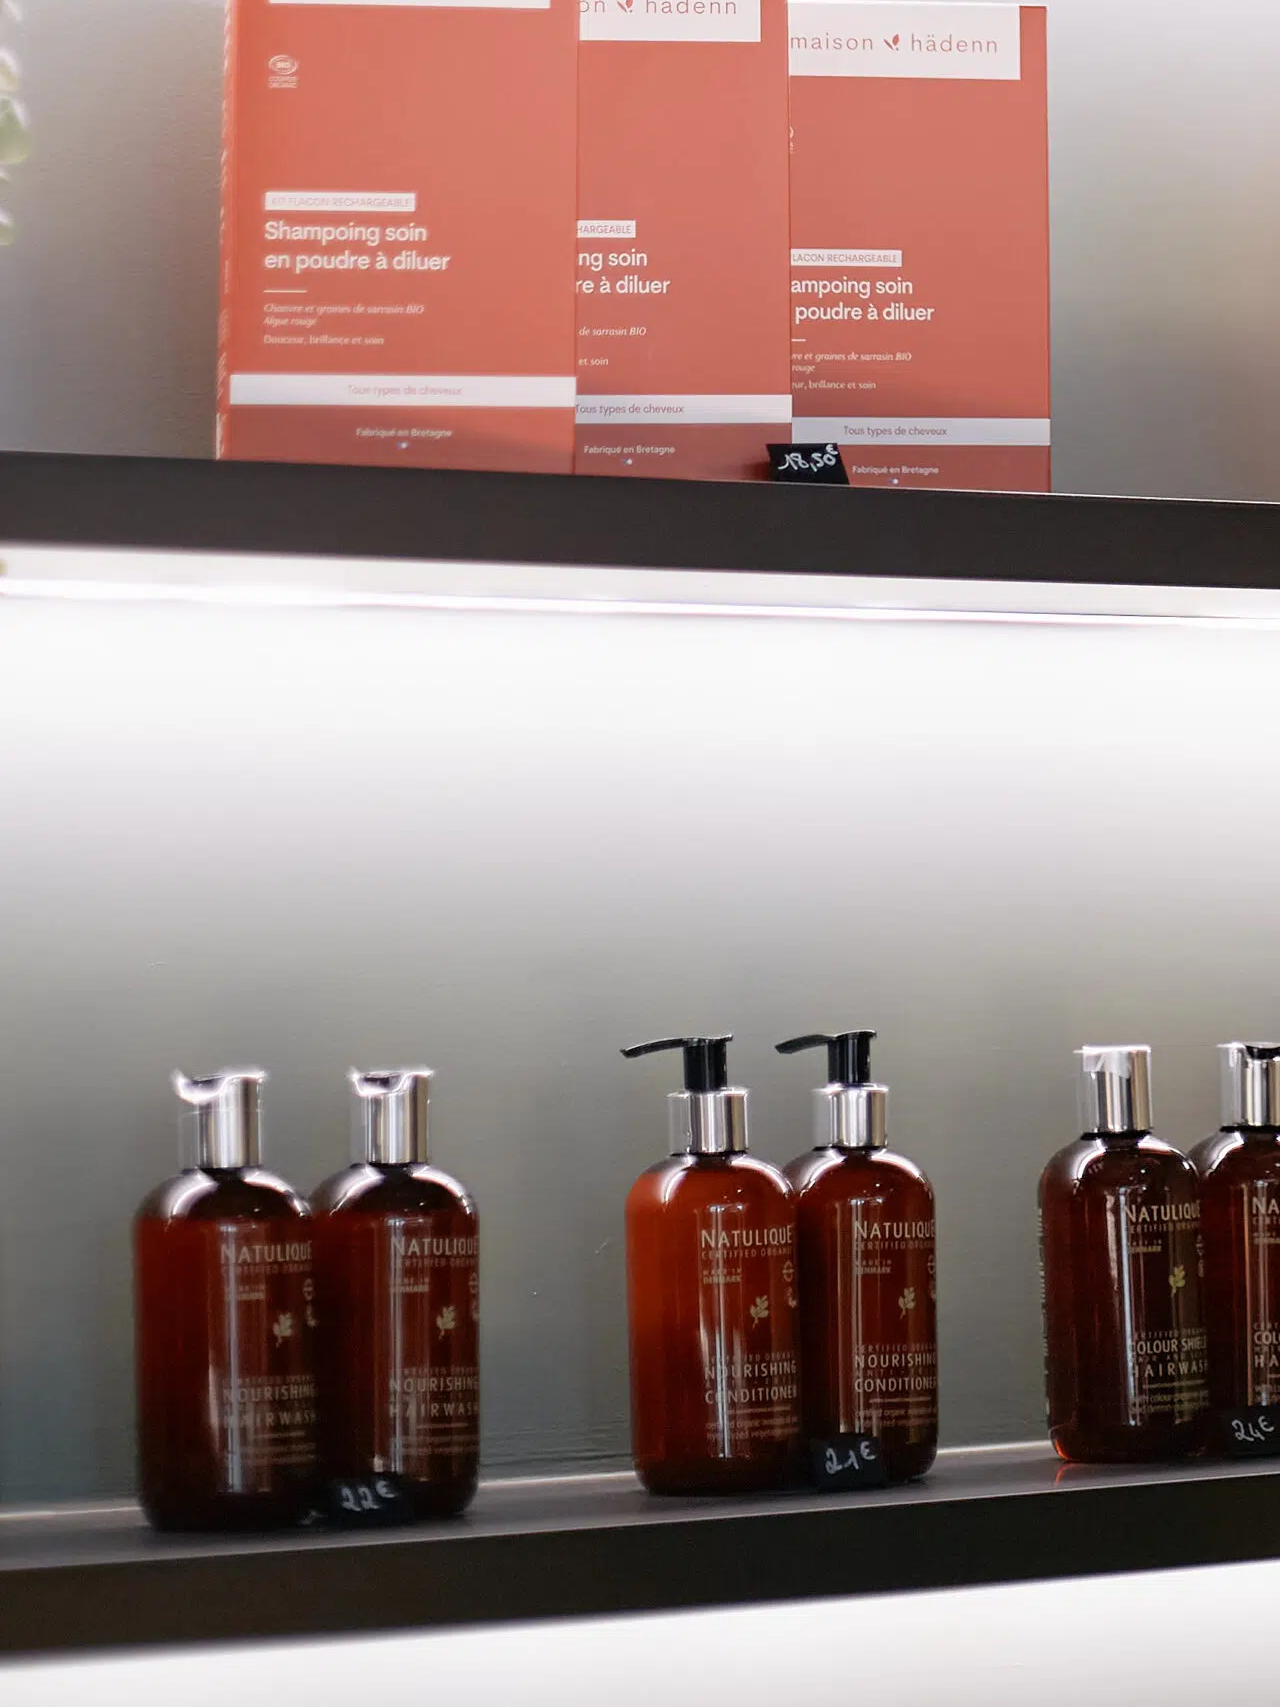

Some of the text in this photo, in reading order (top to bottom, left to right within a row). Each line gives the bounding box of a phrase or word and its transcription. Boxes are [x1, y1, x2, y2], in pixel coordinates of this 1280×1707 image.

[790, 32, 998, 54] maison hädenn
[264, 220, 427, 246] Shampoing soin
[264, 250, 451, 274] en poudre à diluer
[608, 248, 648, 266] soin
[827, 253, 898, 263] RECHARGEABLE
[599, 275, 611, 293] à
[615, 275, 671, 293] diluer
[875, 276, 913, 294] soin
[352, 303, 364, 313] de
[406, 304, 425, 314] BIO
[795, 301, 935, 325] poudre à diluer
[578, 326, 647, 336] de sarrasin BIO
[351, 335, 363, 344] et
[364, 335, 385, 344] soin
[578, 357, 609, 366] et soin
[847, 351, 859, 361] de
[895, 351, 912, 361] BIO
[847, 381, 856, 389] et
[858, 380, 877, 389] soin
[575, 403, 685, 416] Tous types de cheveux
[843, 425, 948, 437] Tous types de cheveux
[583, 444, 676, 456] Fabriqué en Bretagne
[852, 465, 889, 476] Fabriqué
[901, 466, 939, 476] Bretagne
[701, 1223, 794, 1248] NATULIQUE
[854, 1219, 936, 1240] NATULIQUE
[704, 1360, 797, 1380] NOURISHING
[1231, 1415, 1275, 1441] 24€
